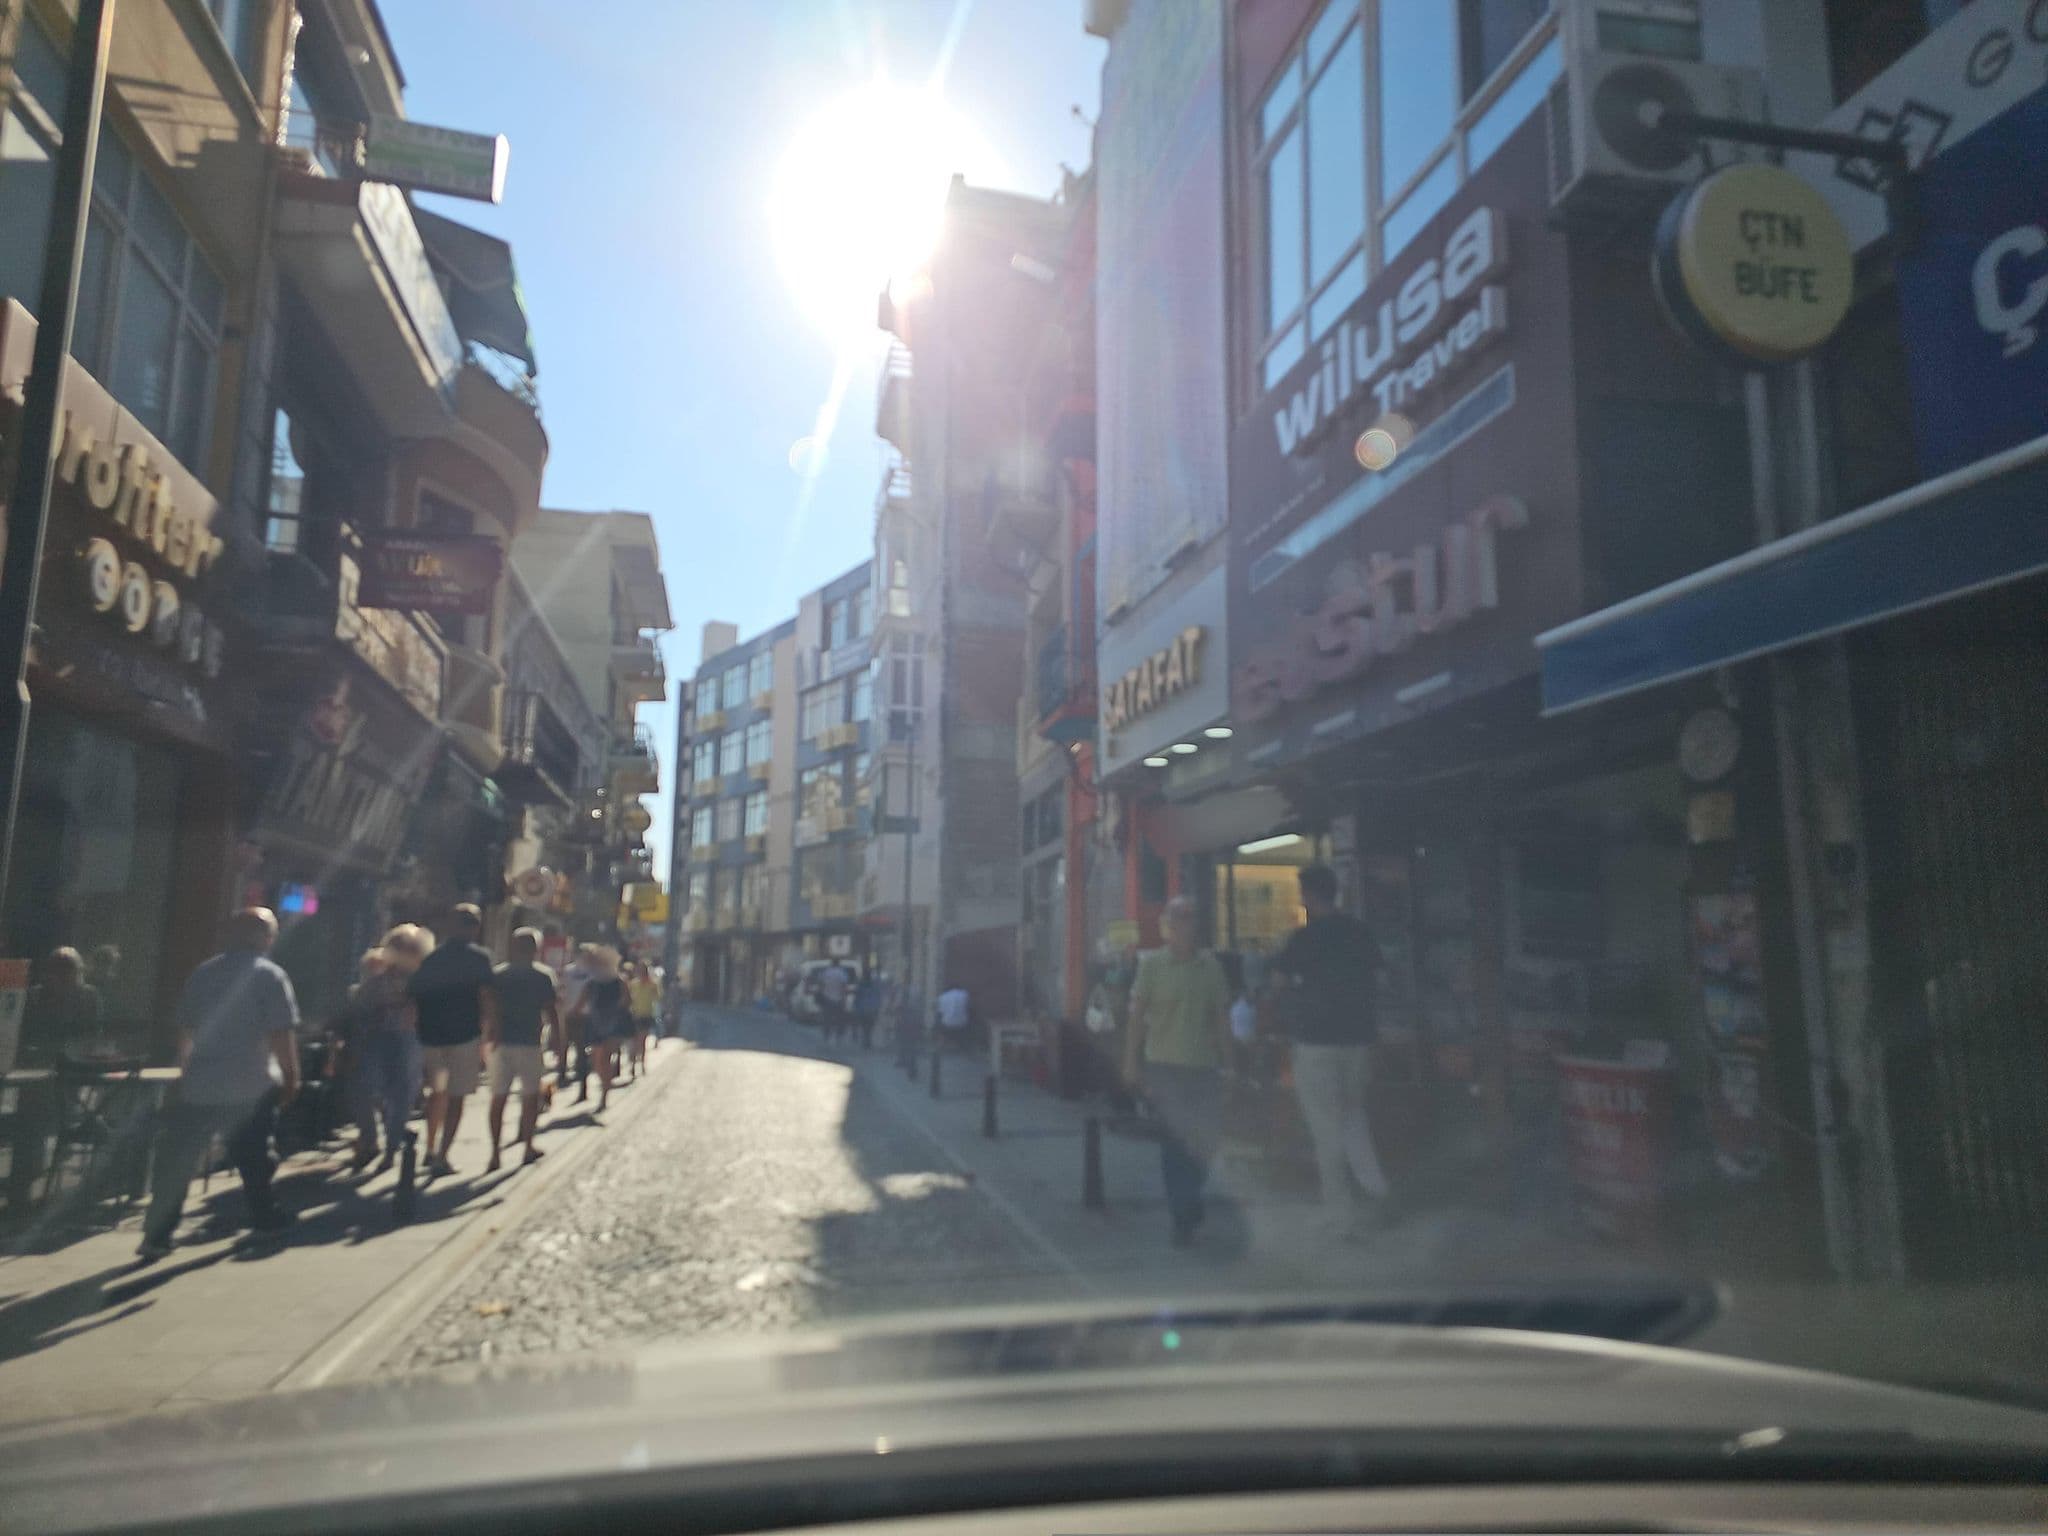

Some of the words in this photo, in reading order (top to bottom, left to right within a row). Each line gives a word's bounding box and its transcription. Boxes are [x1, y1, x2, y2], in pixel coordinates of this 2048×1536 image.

[1738, 209, 1805, 250] ÇTN
[1734, 257, 1819, 304] BÜFE
[1371, 285, 1505, 414] Travel
